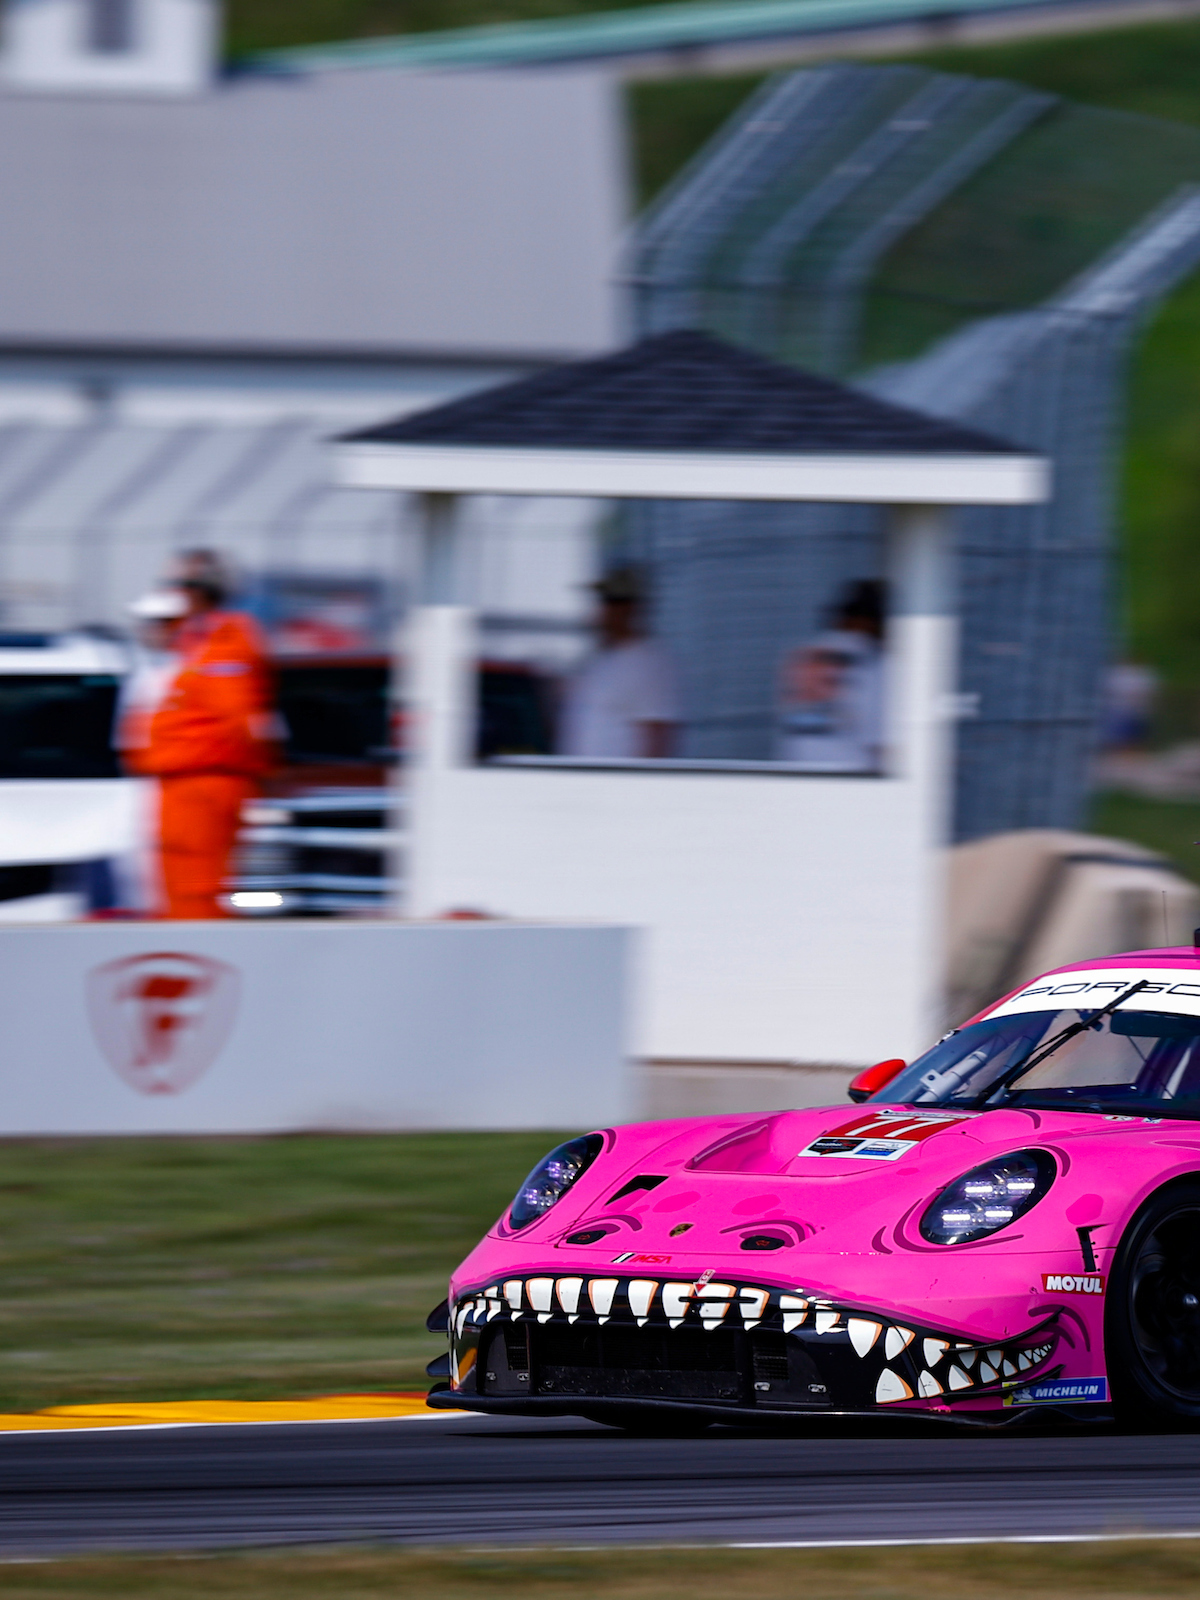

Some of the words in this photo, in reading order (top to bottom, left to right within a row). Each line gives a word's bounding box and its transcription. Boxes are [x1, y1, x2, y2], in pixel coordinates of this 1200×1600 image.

[845, 1115, 955, 1138] 77
[1046, 1275, 1102, 1293] MOTUL
[1035, 1385, 1099, 1397] MICHELIN
